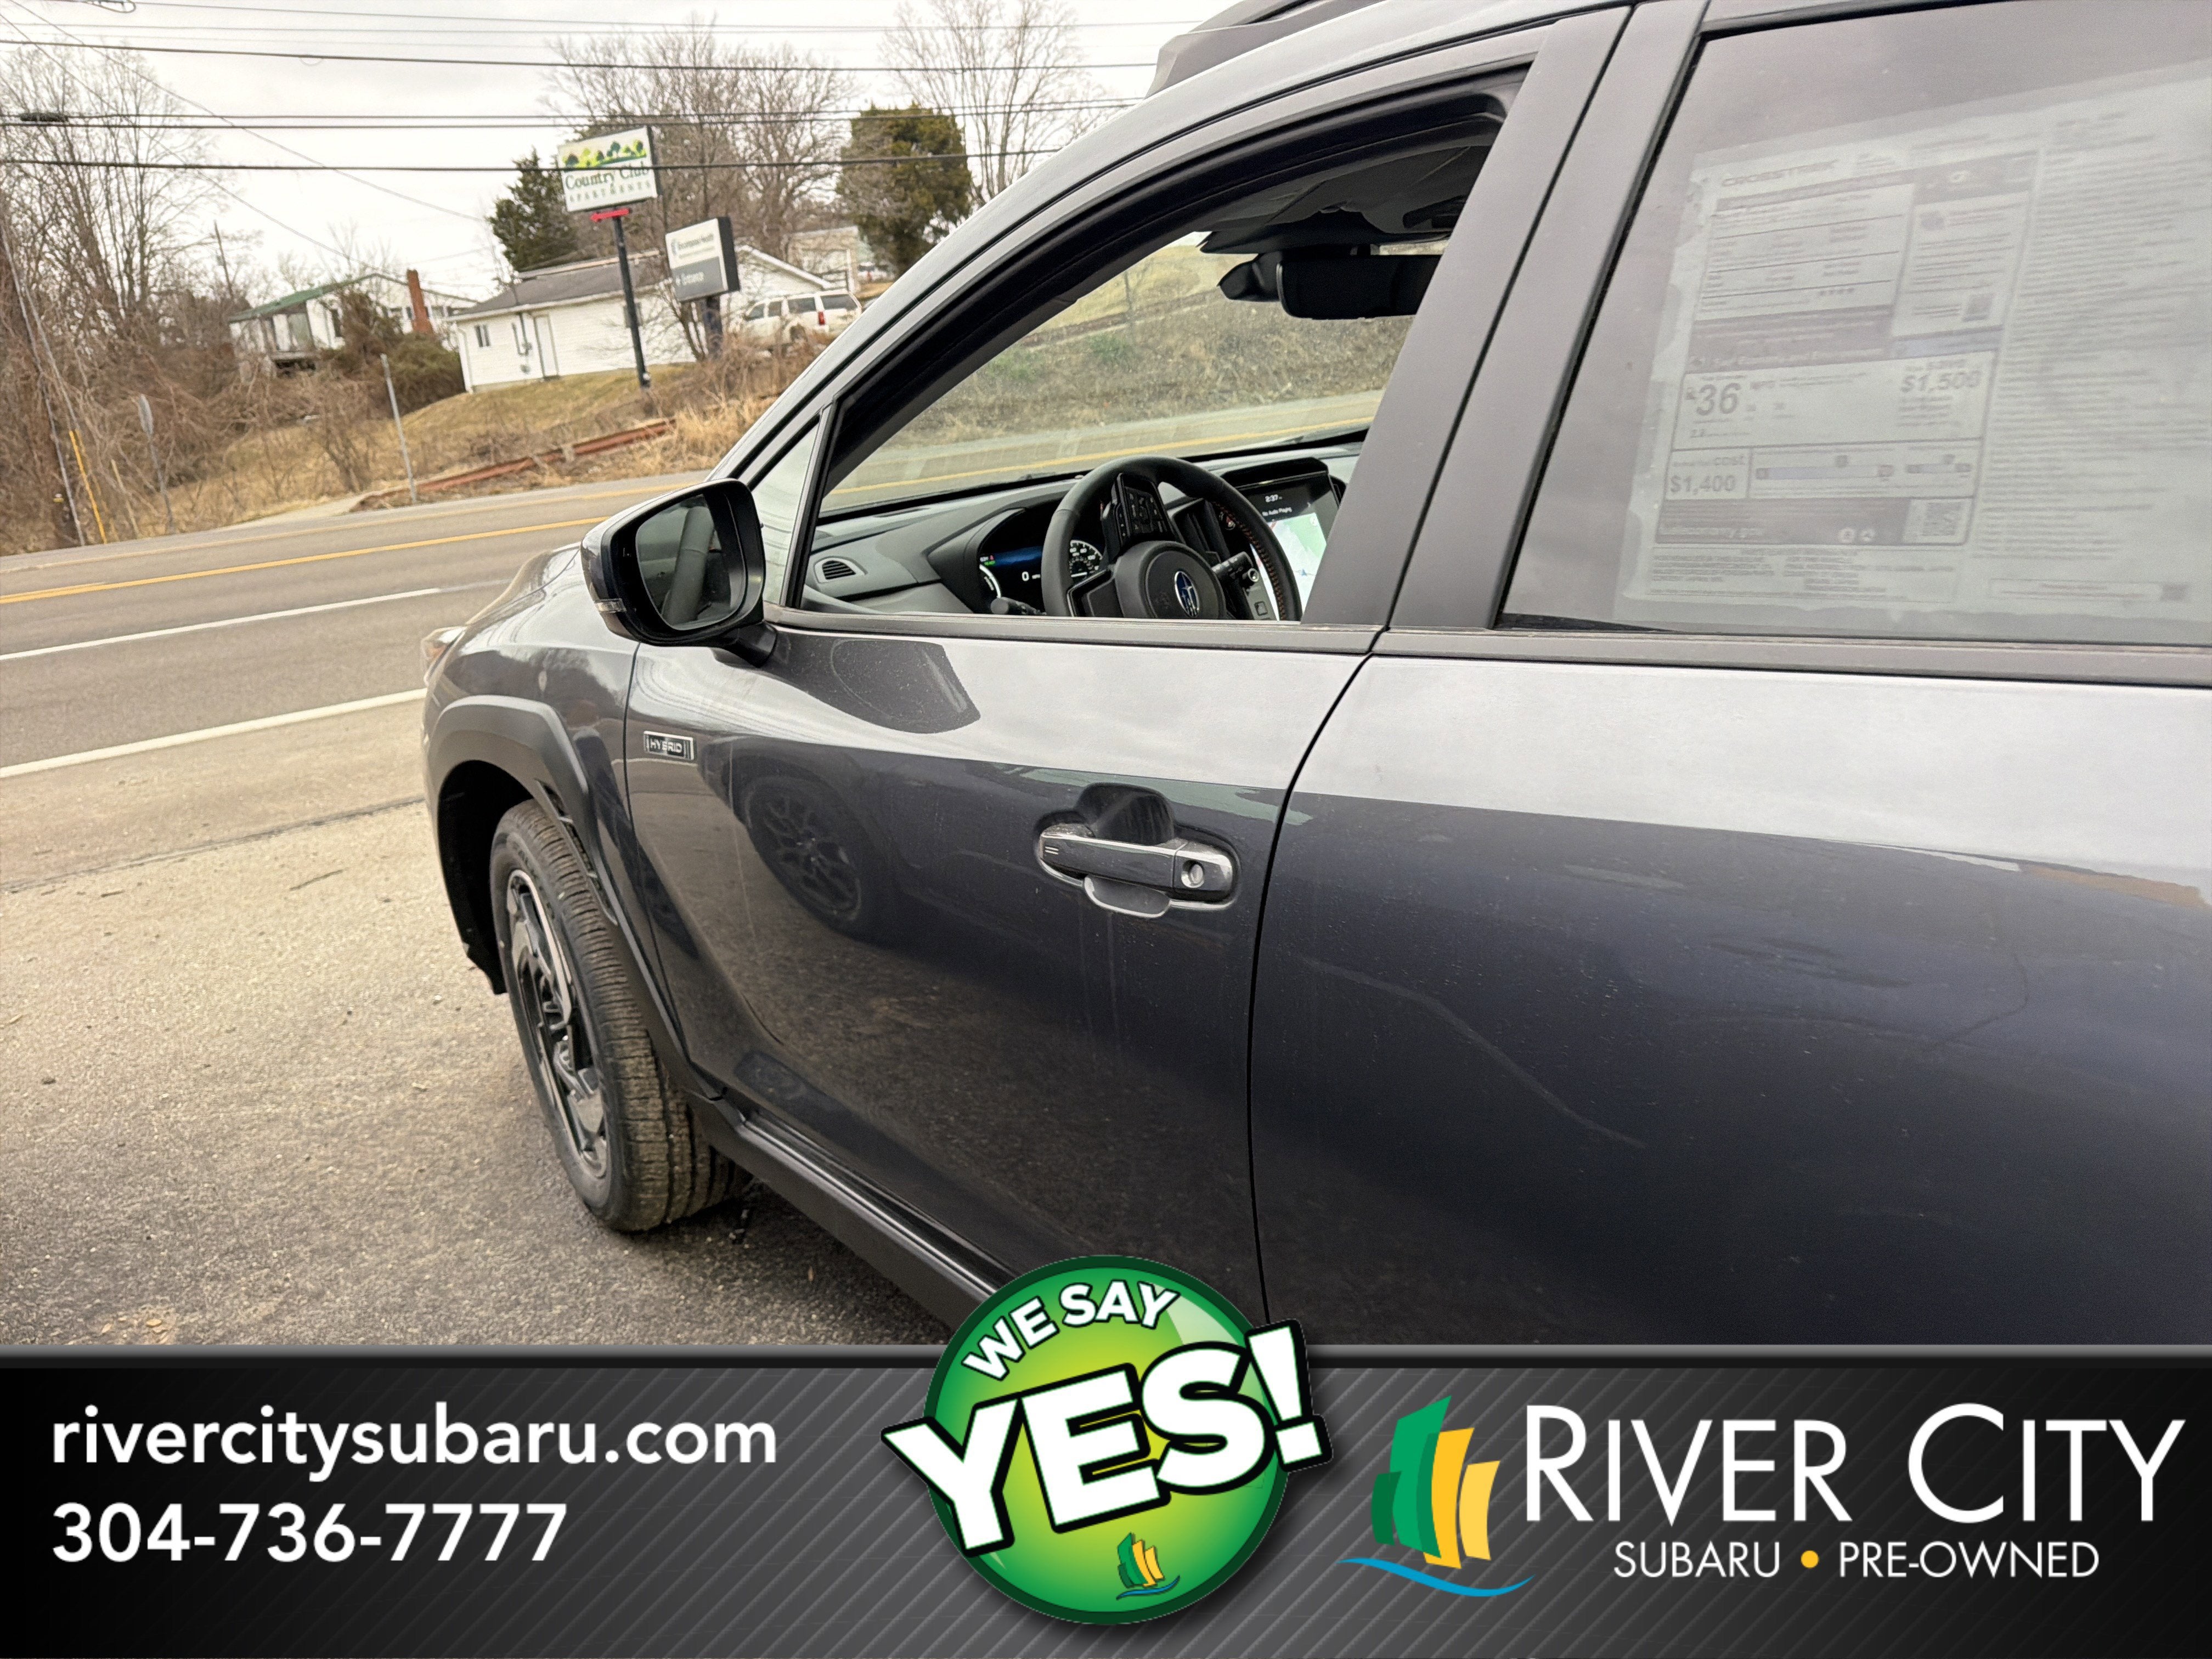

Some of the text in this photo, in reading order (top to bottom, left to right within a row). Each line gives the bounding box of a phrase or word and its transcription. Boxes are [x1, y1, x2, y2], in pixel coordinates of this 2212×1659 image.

[566, 160, 649, 190] Country Club
[1900, 369, 1982, 393] $1,500
[1696, 382, 1742, 416] 36
[1670, 474, 1737, 495] $1,400
[650, 738, 682, 753] HYBRID
